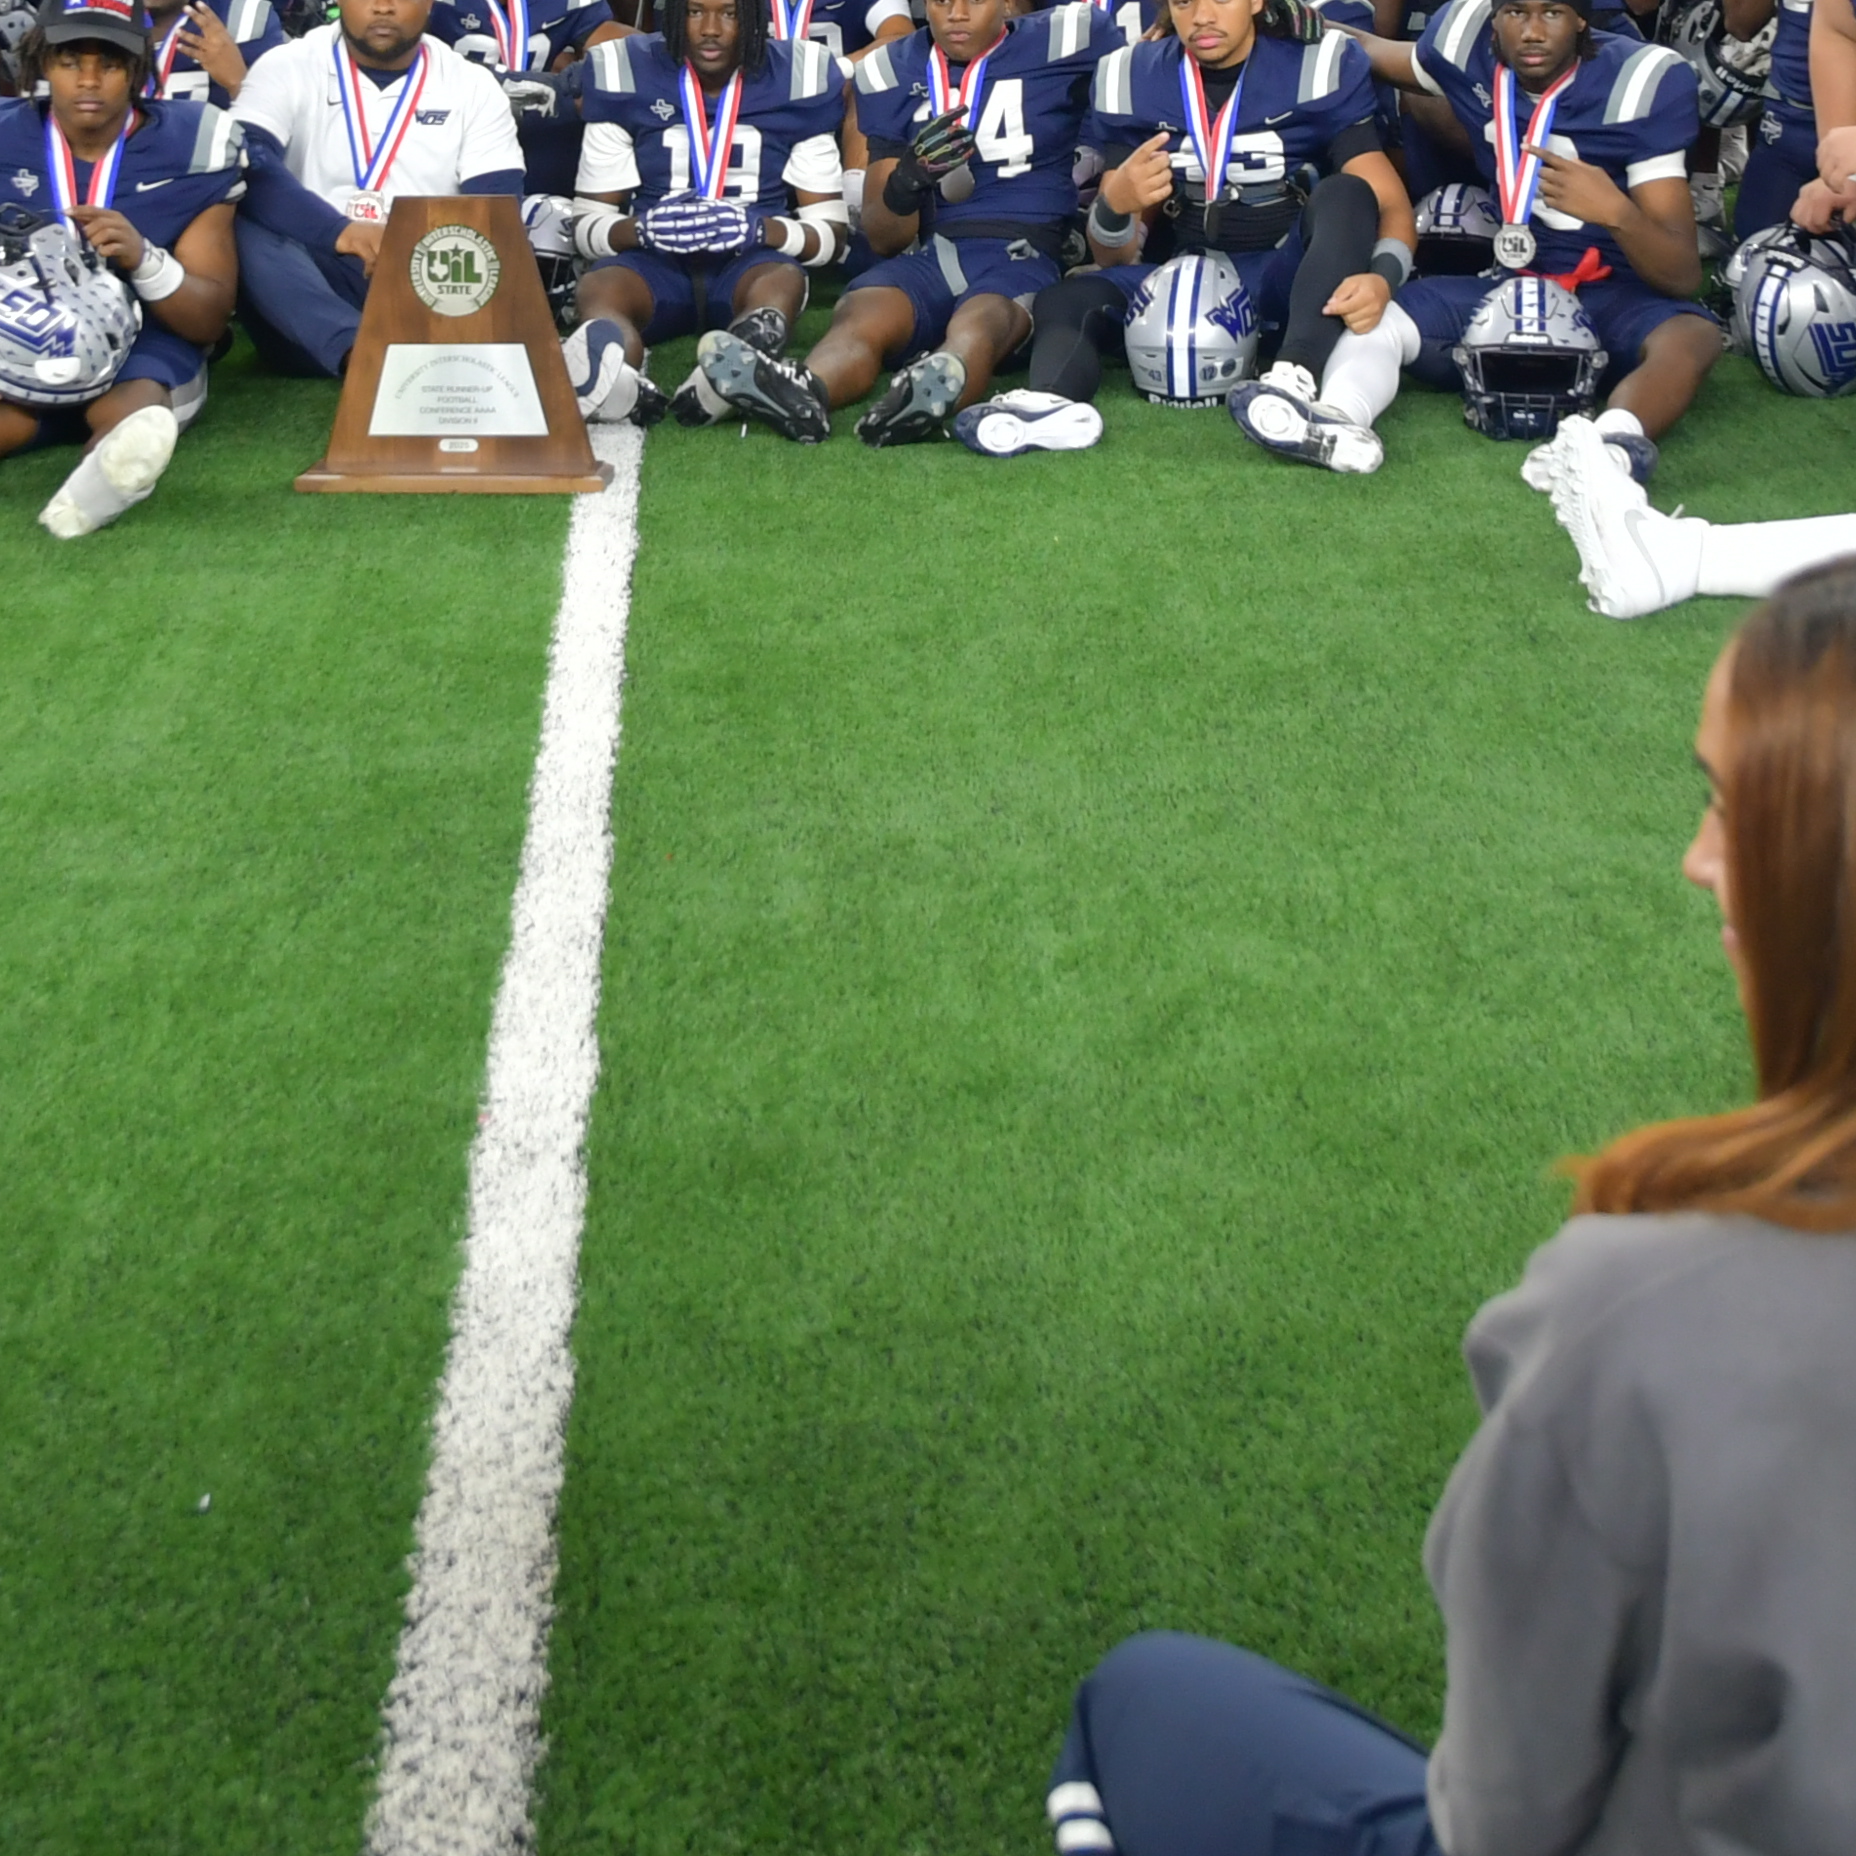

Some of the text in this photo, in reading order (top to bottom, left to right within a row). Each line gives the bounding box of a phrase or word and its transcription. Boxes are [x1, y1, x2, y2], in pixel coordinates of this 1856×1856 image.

[413, 108, 452, 127] WOS
[911, 78, 1034, 179] 4
[436, 284, 473, 296] STATE
[421, 384, 494, 395] STATE RUNNER-UP
[437, 395, 478, 405] FOOTBALL
[419, 405, 472, 415] CONFERENCE
[438, 415, 472, 426] DIVISION
